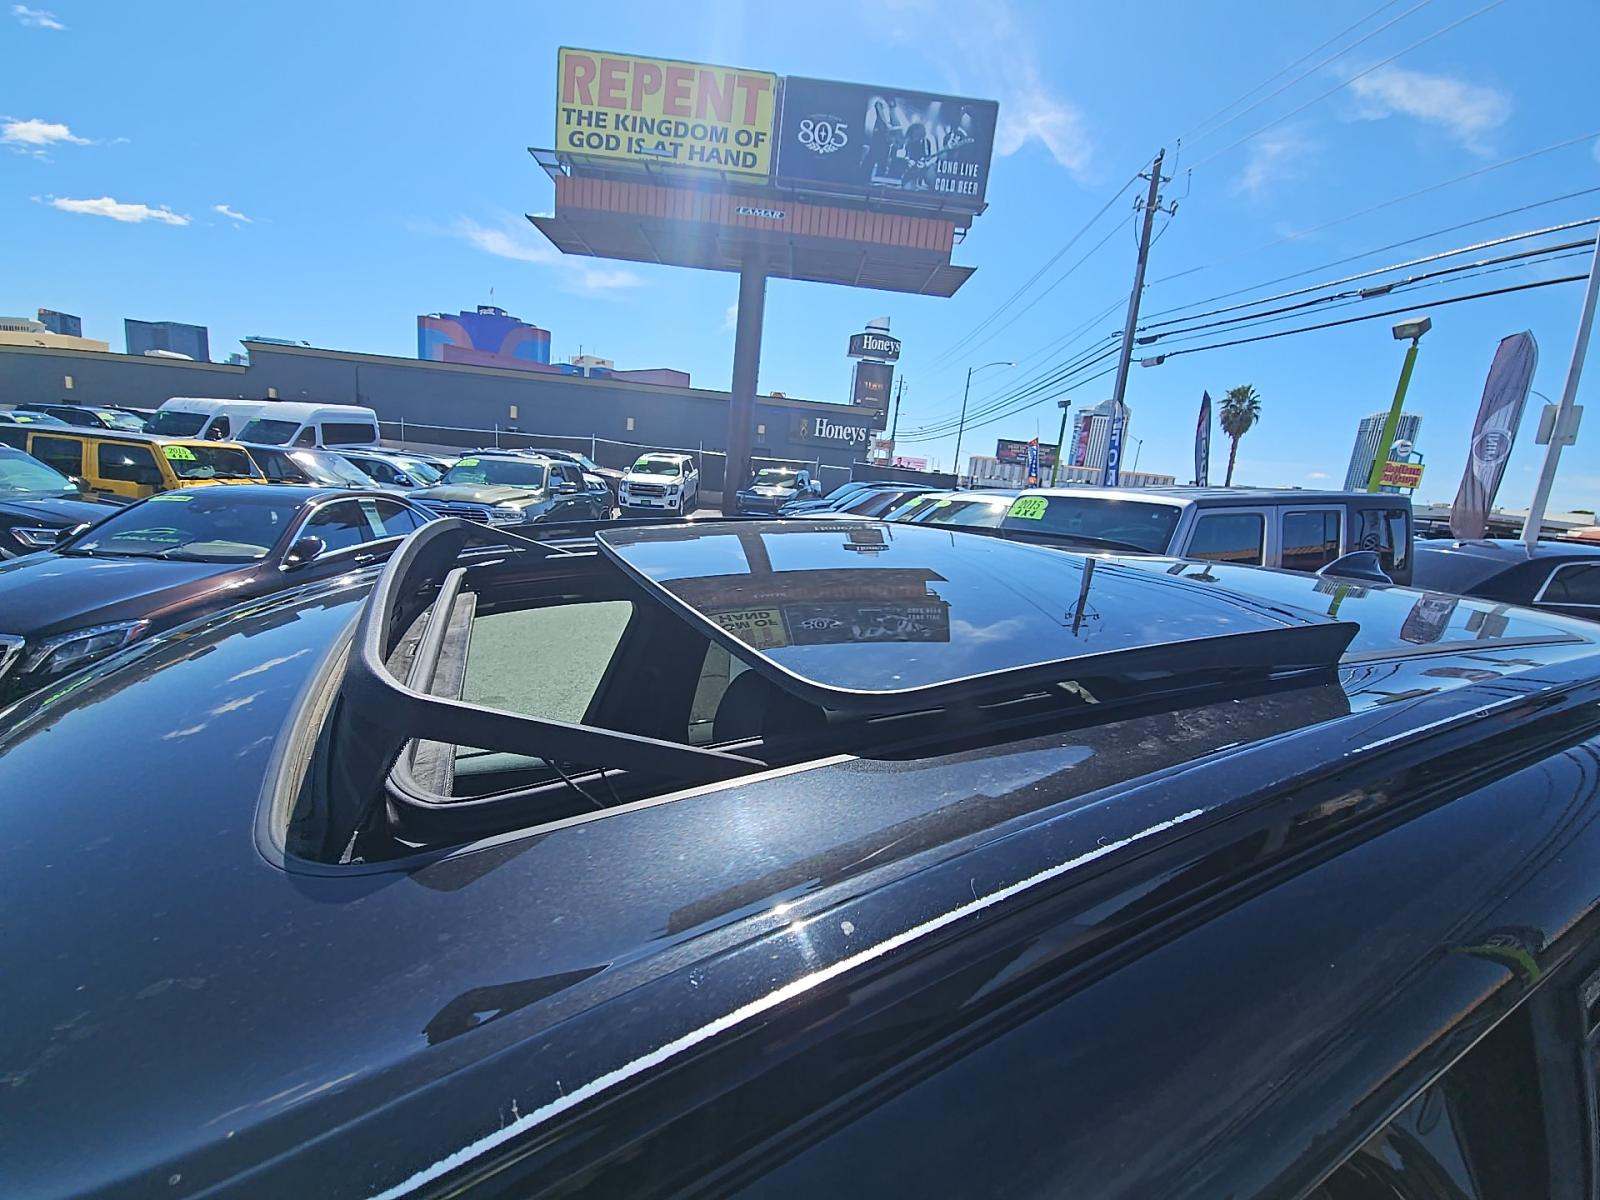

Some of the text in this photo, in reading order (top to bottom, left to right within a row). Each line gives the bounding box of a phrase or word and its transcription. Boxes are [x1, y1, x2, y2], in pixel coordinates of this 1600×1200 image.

[562, 54, 770, 126] REPENT
[562, 107, 767, 148] THE KINGDOM OF
[799, 119, 848, 147] 805
[568, 130, 621, 151] GOD
[627, 136, 645, 154] IS
[654, 141, 683, 159] AT
[688, 144, 757, 169] HAND
[937, 160, 979, 178] LONG LIVE
[934, 177, 979, 195] COLD BEER
[862, 334, 901, 355] Honeys
[814, 417, 867, 446] Honeys
